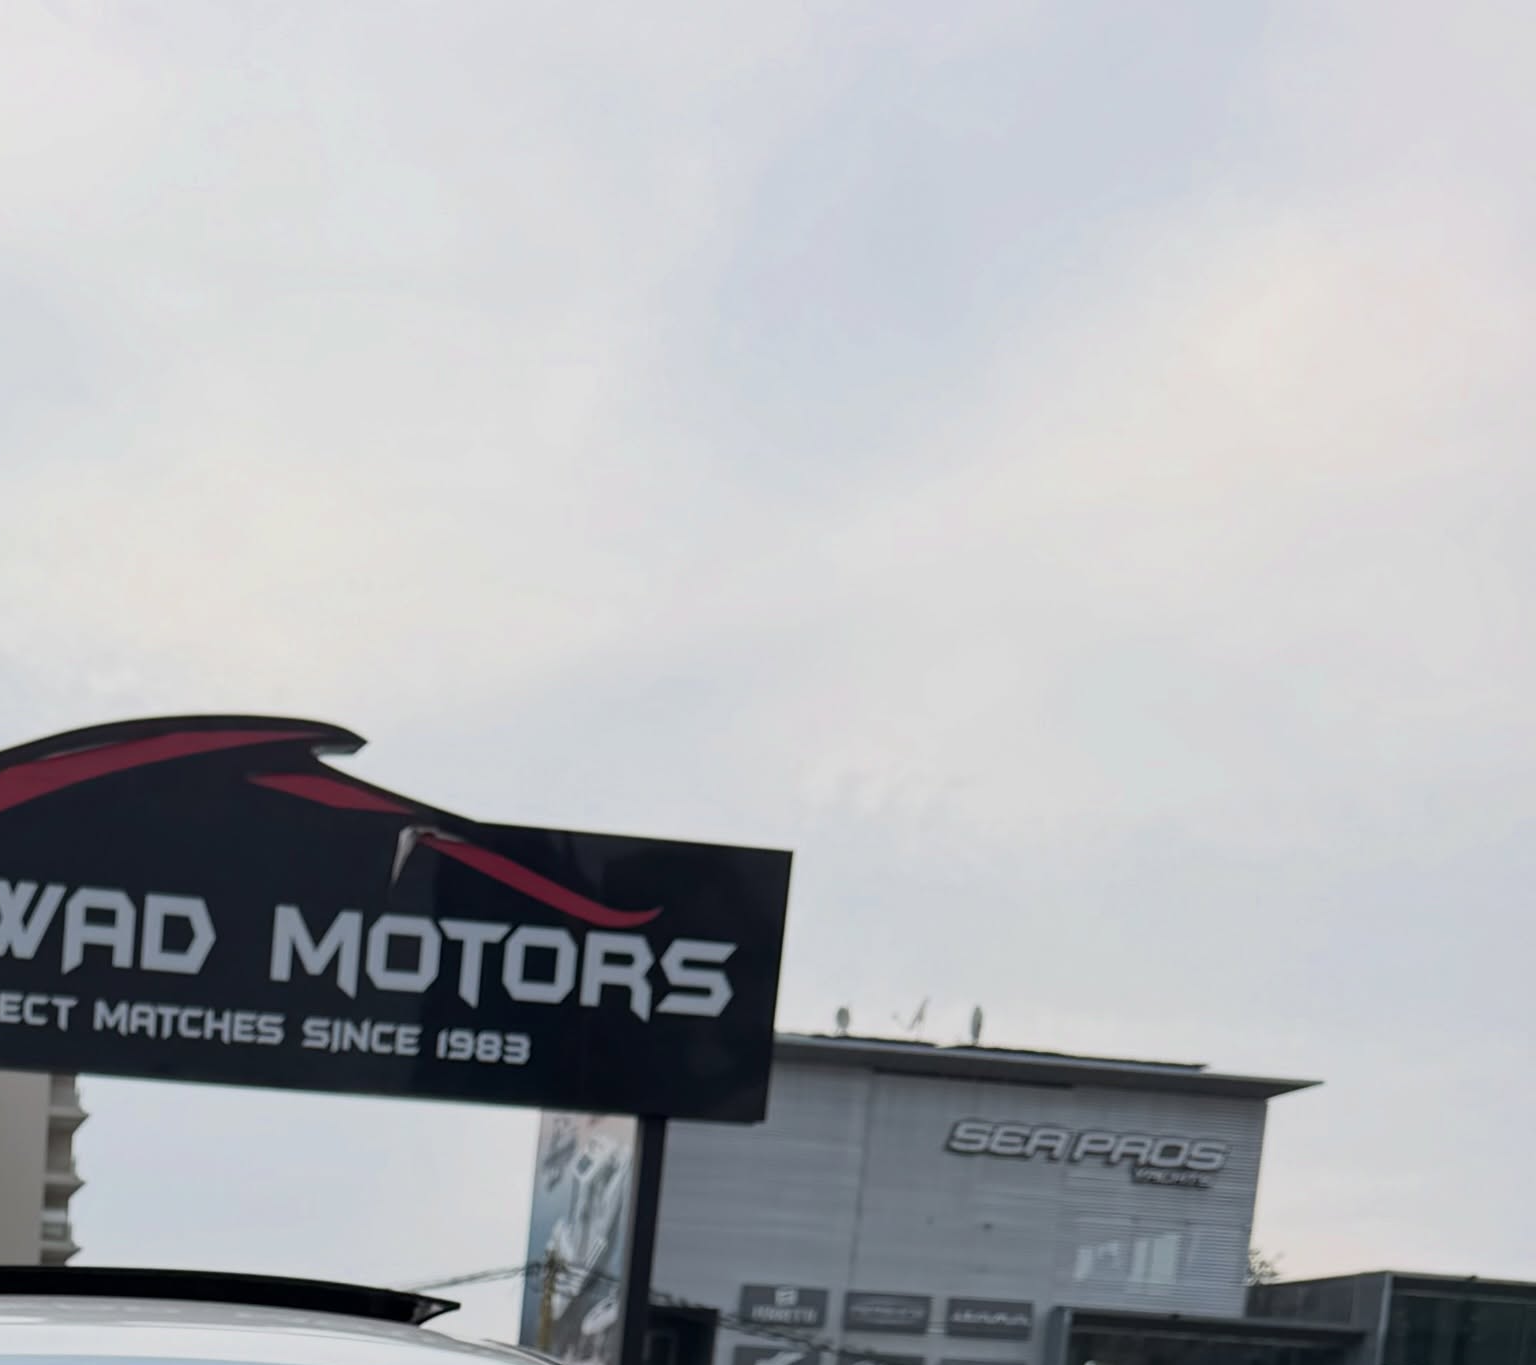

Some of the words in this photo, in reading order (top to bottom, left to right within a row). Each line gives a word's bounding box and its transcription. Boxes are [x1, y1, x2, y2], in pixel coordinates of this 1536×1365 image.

[270, 905, 737, 1023] MOTORS
[93, 999, 285, 1046] MATCHES
[302, 1018, 423, 1055] SINCE
[436, 1028, 532, 1065] 1983
[949, 1120, 1066, 1161] SEA
